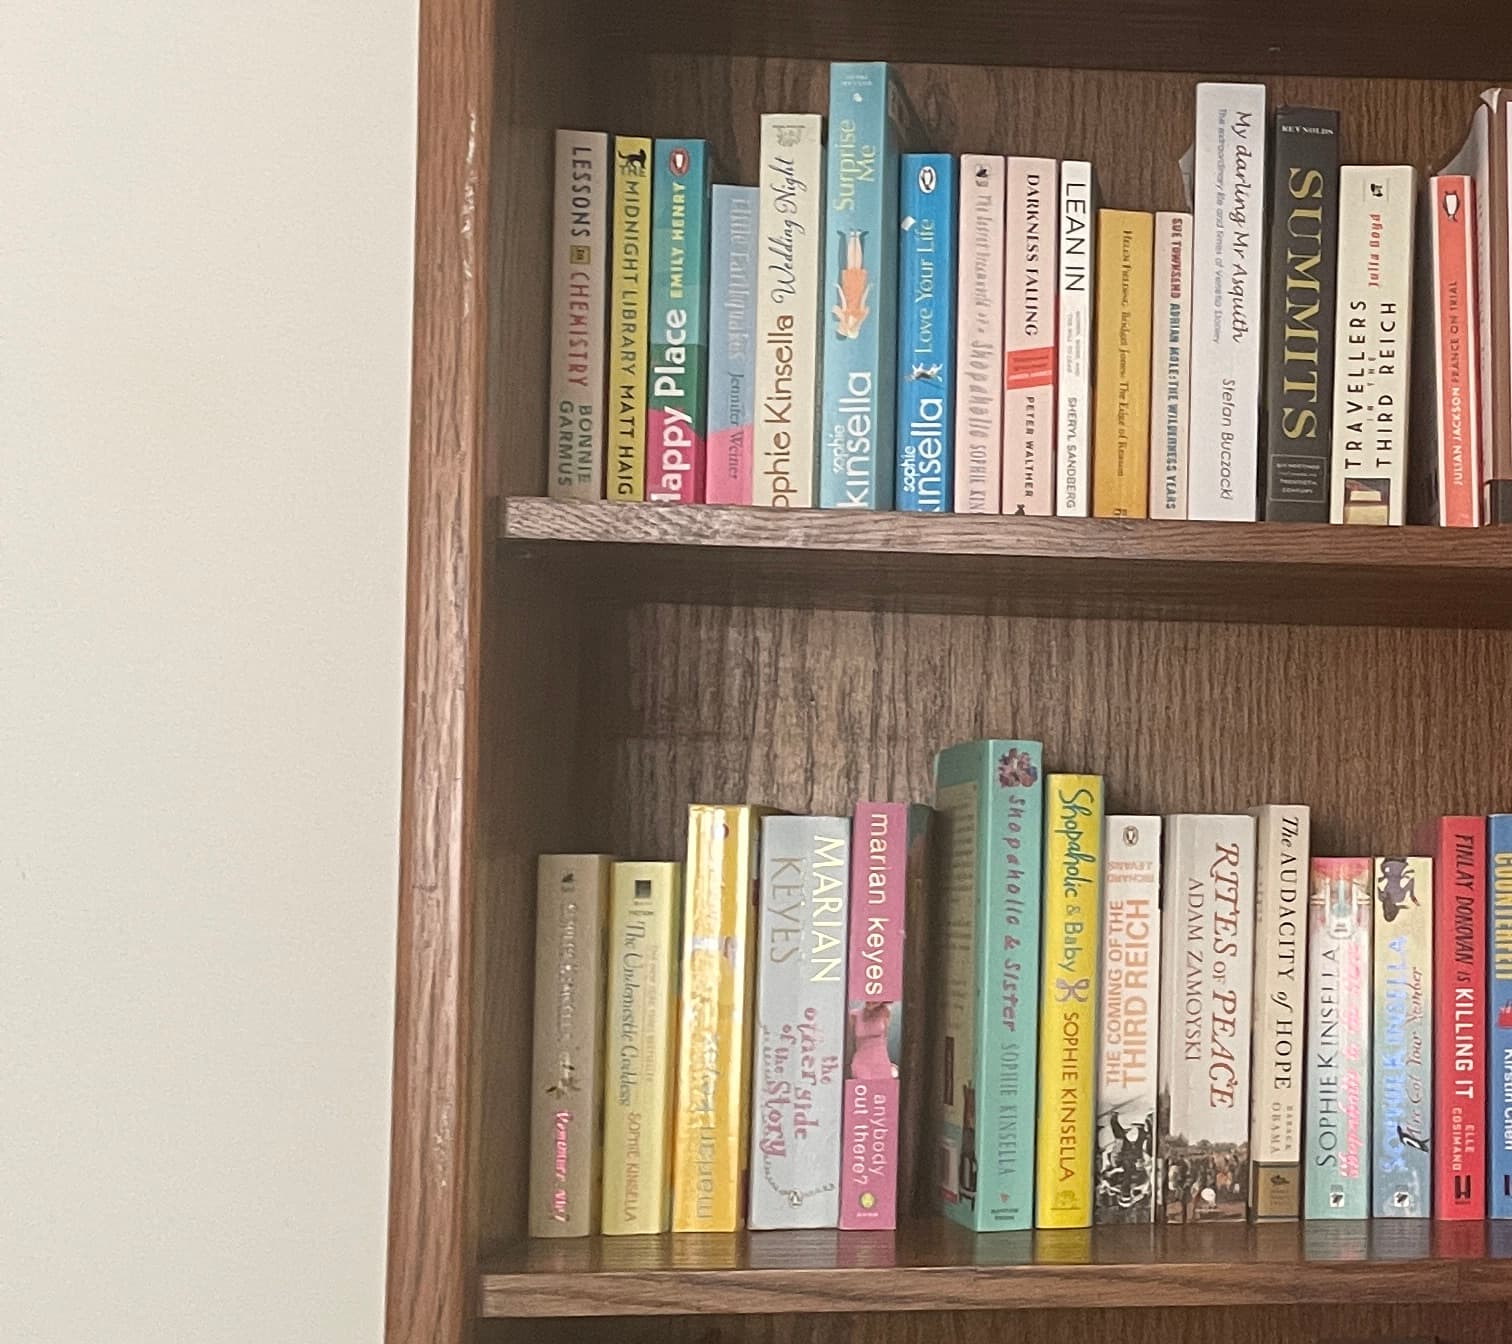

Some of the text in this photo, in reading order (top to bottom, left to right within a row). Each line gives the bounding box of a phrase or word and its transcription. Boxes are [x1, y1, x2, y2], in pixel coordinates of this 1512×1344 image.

[572, 147, 591, 238] LESSONS
[1025, 174, 1039, 337] DARKNESS FALLING
[1065, 183, 1087, 291] LEAN IN
[568, 272, 589, 387] CHEMISTRY
[619, 182, 639, 377] MIDNIGHT LIBRARY
[1282, 167, 1324, 440] SUMMITS
[617, 385, 634, 495] MATT HAIG
[1066, 398, 1076, 509] SHERYL SANDBERG
[1346, 300, 1366, 469] TRAVELLERS
[1376, 302, 1396, 468] THIRD REICH
[811, 835, 844, 983] MARIAN
[864, 813, 889, 995] marian keyes
[1270, 816, 1299, 1090] The AUDACITY of HOPE
[1122, 900, 1150, 1087] THIRD REICH
[1454, 988, 1474, 1098] KILLING IT
[1059, 1012, 1079, 1182] SOPHIE KINSELLA
